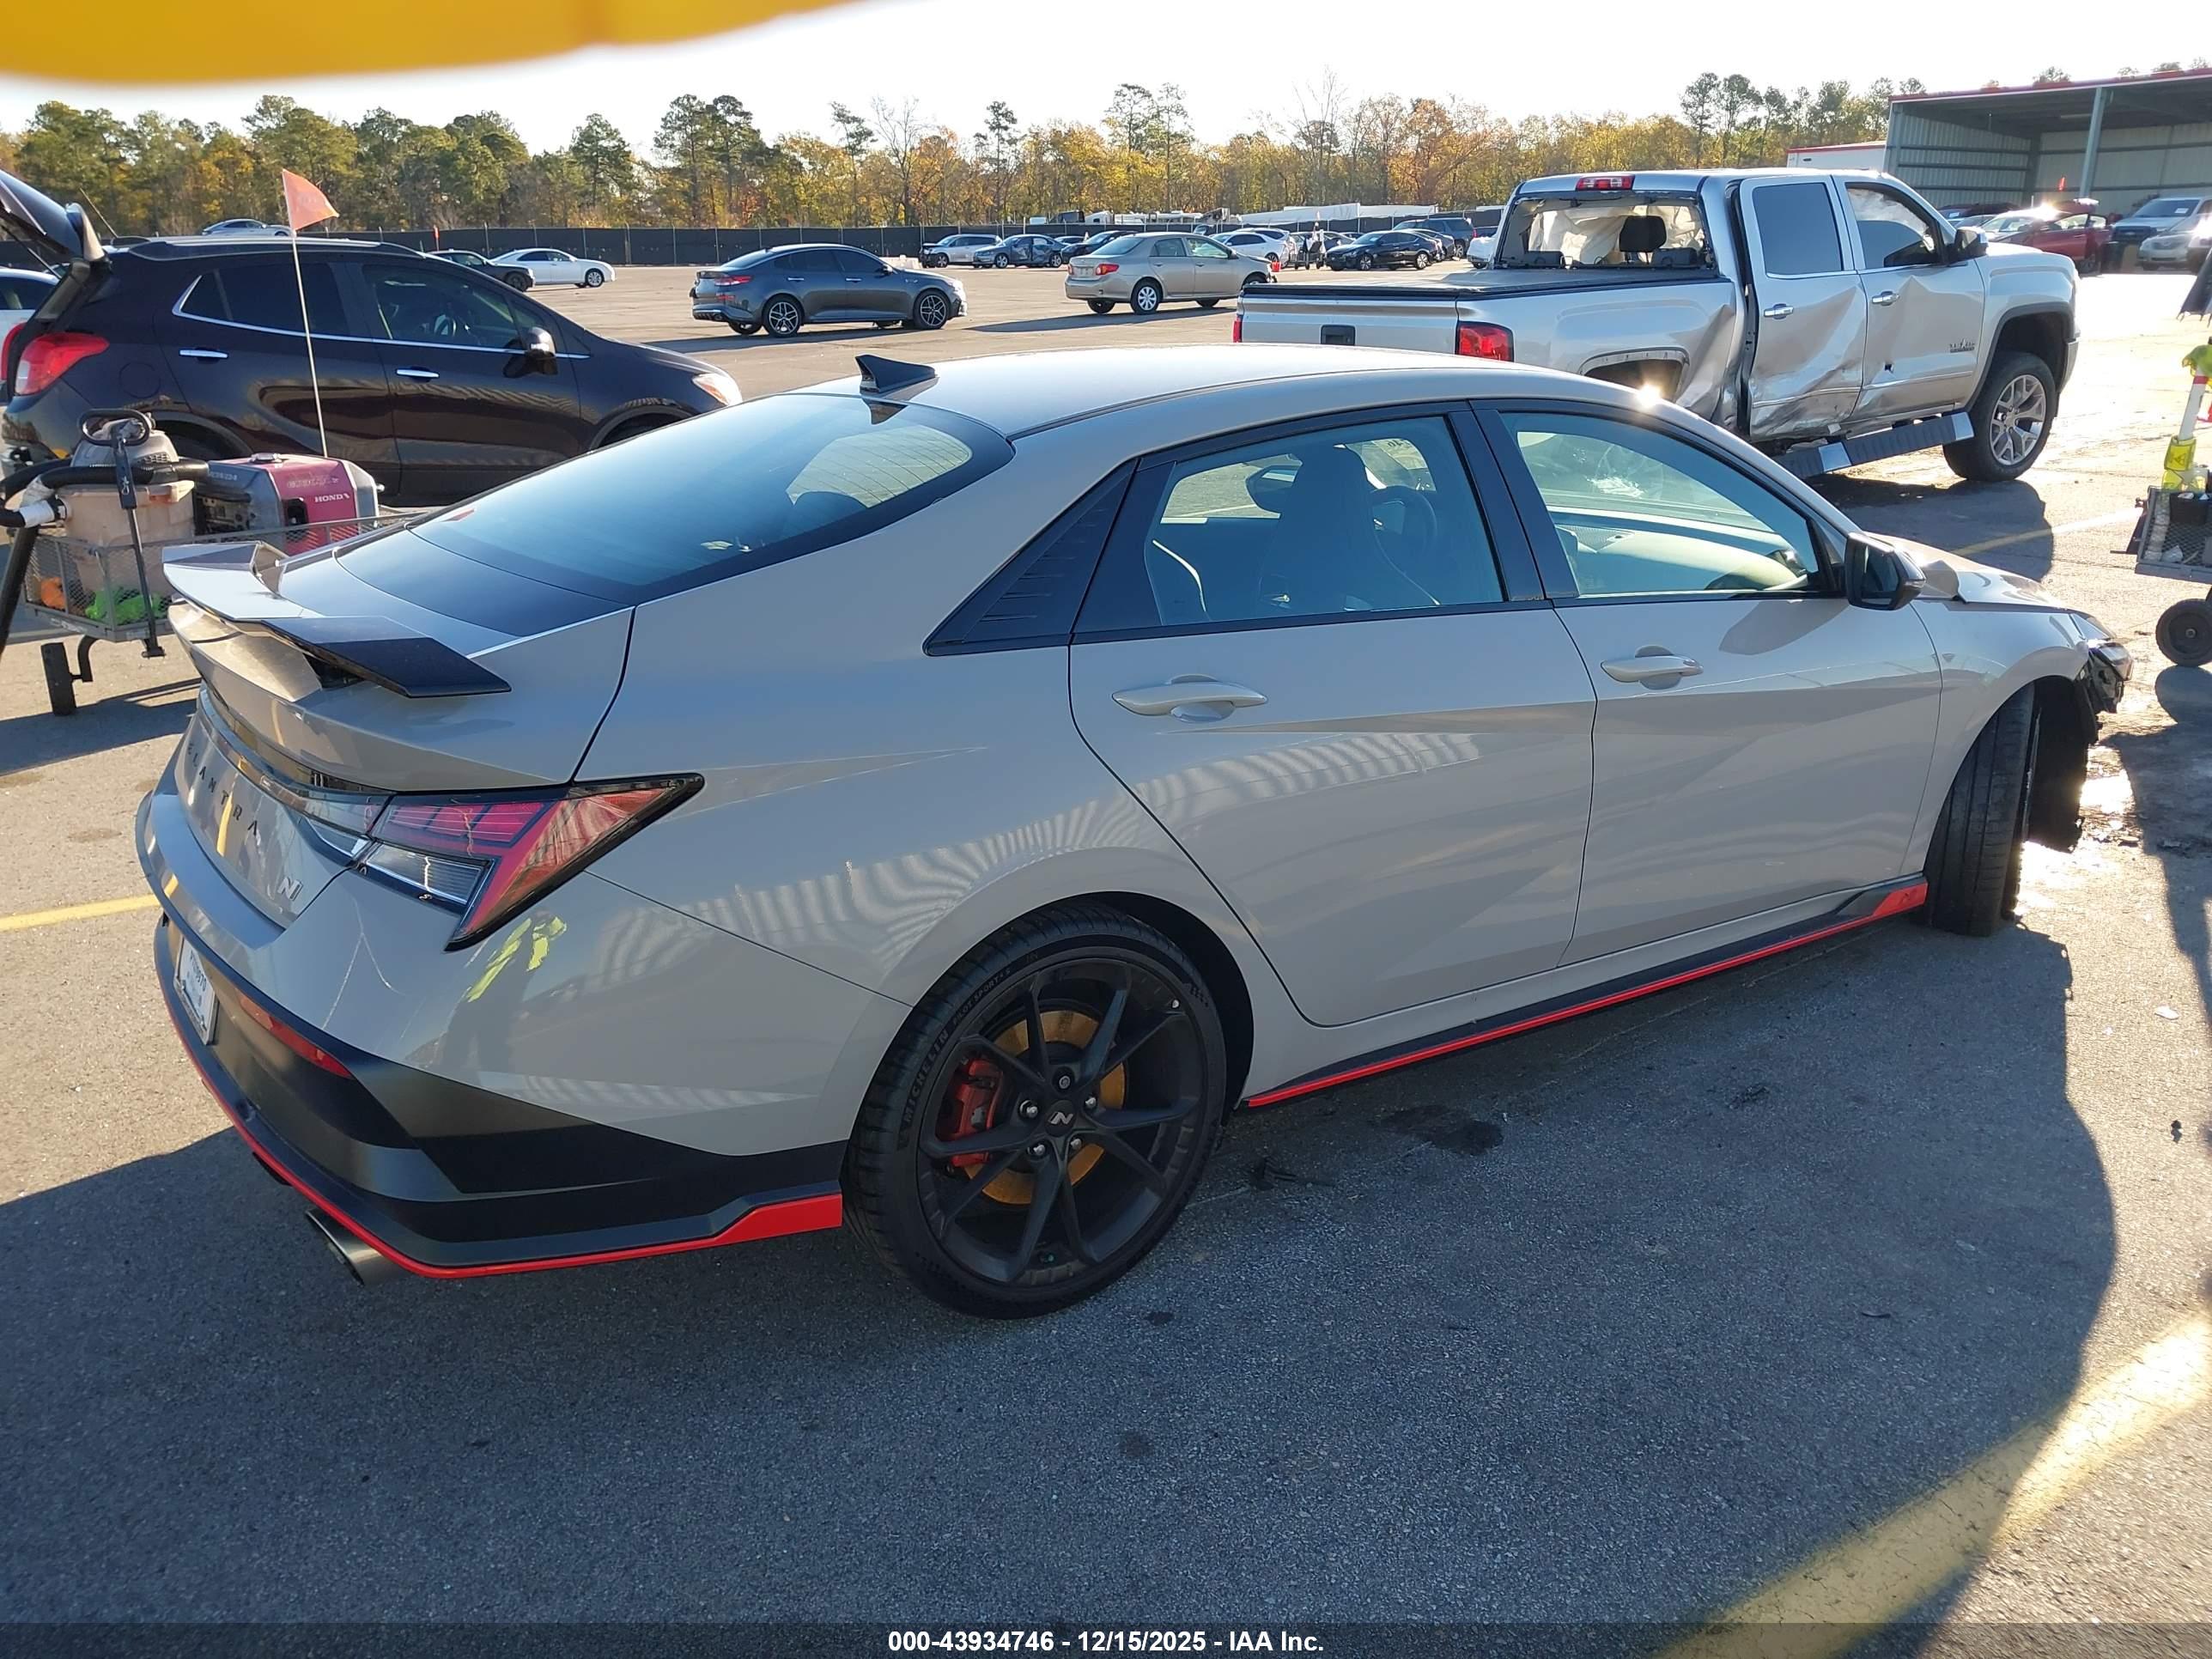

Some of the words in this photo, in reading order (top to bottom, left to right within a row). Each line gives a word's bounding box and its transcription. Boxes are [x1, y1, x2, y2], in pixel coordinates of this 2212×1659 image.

[314, 493, 350, 503] HONDA
[187, 743, 258, 836] ELANTRA
[904, 1029, 950, 1123] MICHELIN
[974, 978, 1000, 1001] SPORT
